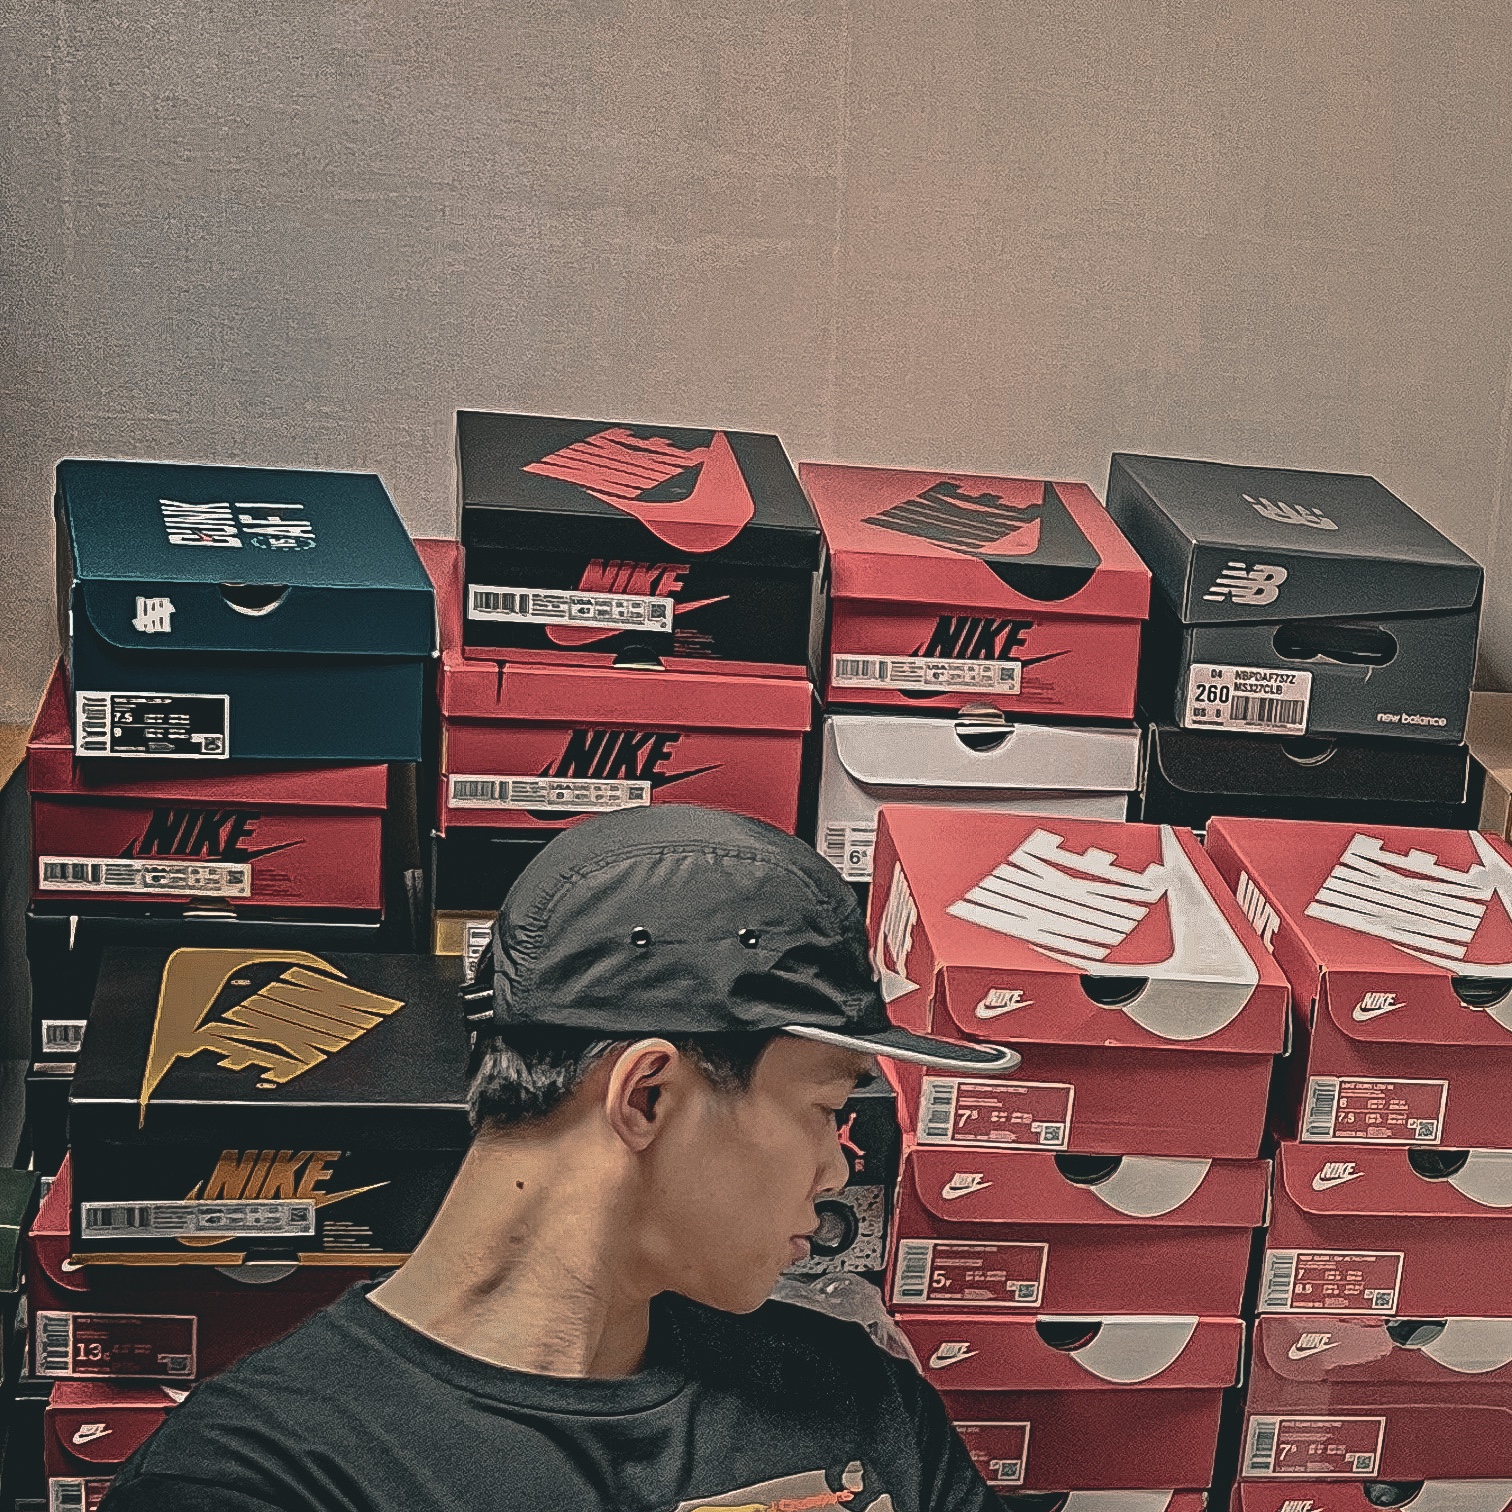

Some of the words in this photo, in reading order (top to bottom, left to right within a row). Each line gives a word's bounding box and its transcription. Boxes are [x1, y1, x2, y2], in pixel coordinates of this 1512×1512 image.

[579, 558, 691, 596] NIKE
[925, 616, 1035, 659] NIKE
[1195, 684, 1230, 704] 260
[1377, 713, 1400, 723] new
[1402, 713, 1447, 726] balance
[550, 729, 682, 777] NIKE
[136, 808, 262, 855] NIKE
[1362, 992, 1397, 1009] NIKE
[203, 1150, 341, 1200] NIKE
[1321, 1163, 1356, 1178] NIKE
